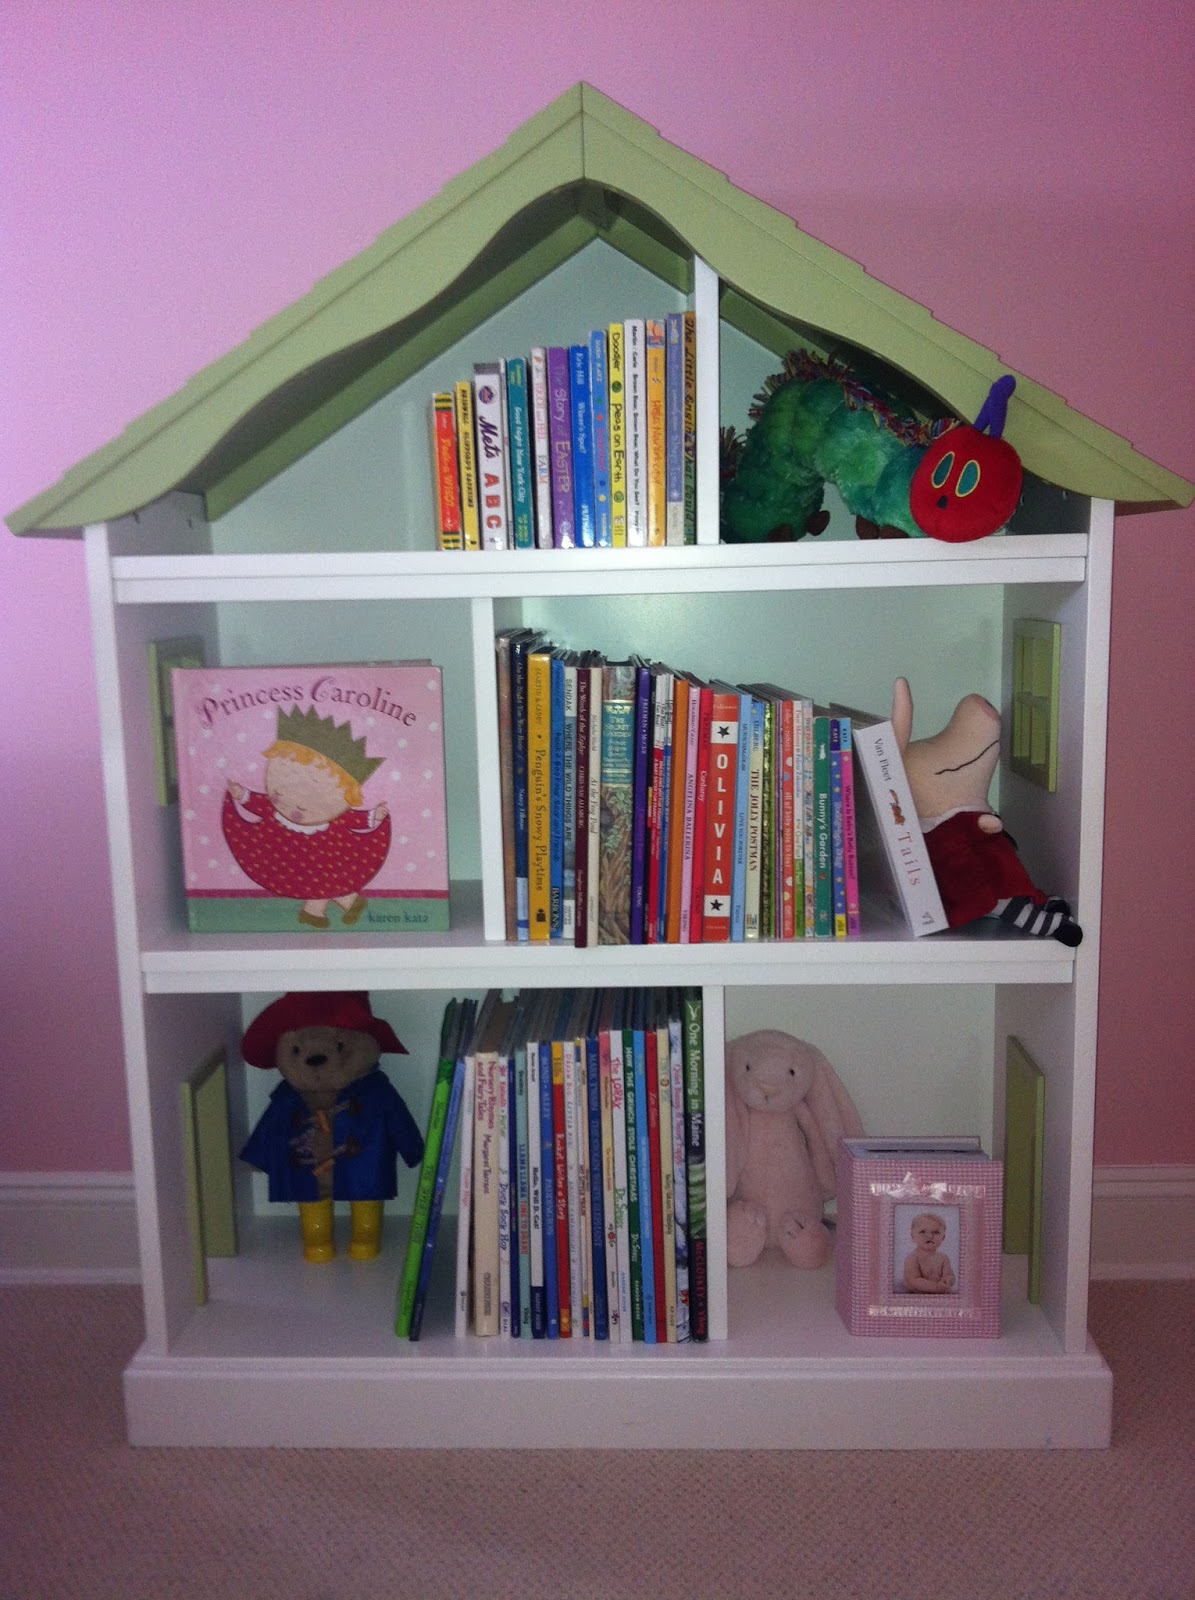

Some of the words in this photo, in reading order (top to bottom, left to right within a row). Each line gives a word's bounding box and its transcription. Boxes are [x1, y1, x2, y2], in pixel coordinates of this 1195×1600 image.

[684, 316, 695, 345] The
[684, 347, 695, 390] Little
[514, 406, 523, 425] Good
[553, 388, 569, 422] Story
[479, 416, 502, 460] Mets
[614, 434, 621, 448] on
[516, 448, 525, 466] New
[613, 449, 625, 483] Earth
[517, 467, 526, 486] York
[634, 468, 640, 478] Do
[517, 486, 527, 504] City
[684, 484, 695, 522] Could
[565, 678, 573, 711] SENDAK
[579, 681, 587, 693] The
[198, 682, 305, 731] Princess
[308, 675, 417, 728] Caroline
[565, 723, 573, 752] WHERE
[875, 737, 887, 758] Van
[532, 749, 547, 802] Penguin's
[565, 754, 573, 771] THE
[565, 772, 573, 794] WILD
[590, 777, 598, 787] At
[591, 788, 599, 800] the
[684, 773, 694, 814] ANGELINA
[698, 770, 707, 802] Corduroy
[751, 769, 760, 791] THE
[565, 795, 573, 823] THINGS
[711, 753, 730, 885] OLIVIA
[750, 793, 760, 821] JOLLY
[817, 792, 828, 831] Bunny's
[532, 805, 547, 842] Snowy
[565, 825, 573, 843] ARE
[683, 816, 693, 861] BALLERINA
[749, 825, 759, 872] POSTMAN
[819, 832, 828, 869] Garden
[532, 844, 548, 892] Playtime
[898, 829, 922, 887] Tails
[367, 908, 401, 925] karen
[403, 908, 430, 924] katz
[689, 1022, 701, 1046] One
[477, 1061, 486, 1077] and
[625, 1046, 633, 1068] HOW
[486, 1060, 497, 1095] Nursery
[626, 1071, 634, 1088] THE
[687, 1049, 701, 1096] Morning
[476, 1078, 487, 1100] Fairy
[611, 1077, 623, 1110] LORAX
[477, 1100, 487, 1122] Tales
[487, 1095, 498, 1130] Rhymes
[627, 1090, 635, 1124] GRINCH
[691, 1098, 700, 1111] in
[628, 1126, 636, 1151] STOLE
[691, 1112, 703, 1147] Maine
[482, 1133, 492, 1168] Margaret
[519, 1143, 527, 1171] LLAMA
[483, 1167, 492, 1195] Tarrant
[519, 1171, 528, 1199] LLAMA
[556, 1163, 565, 1189] Writes
[629, 1154, 639, 1203] CHRISTMAS
[499, 1183, 509, 1207] Duck
[615, 1187, 626, 1204] Dr.
[499, 1209, 509, 1231] Sock
[557, 1198, 567, 1221] Story
[616, 1203, 629, 1230] Seuss
[521, 1220, 528, 1230] TO
[631, 1232, 639, 1245] Dr.
